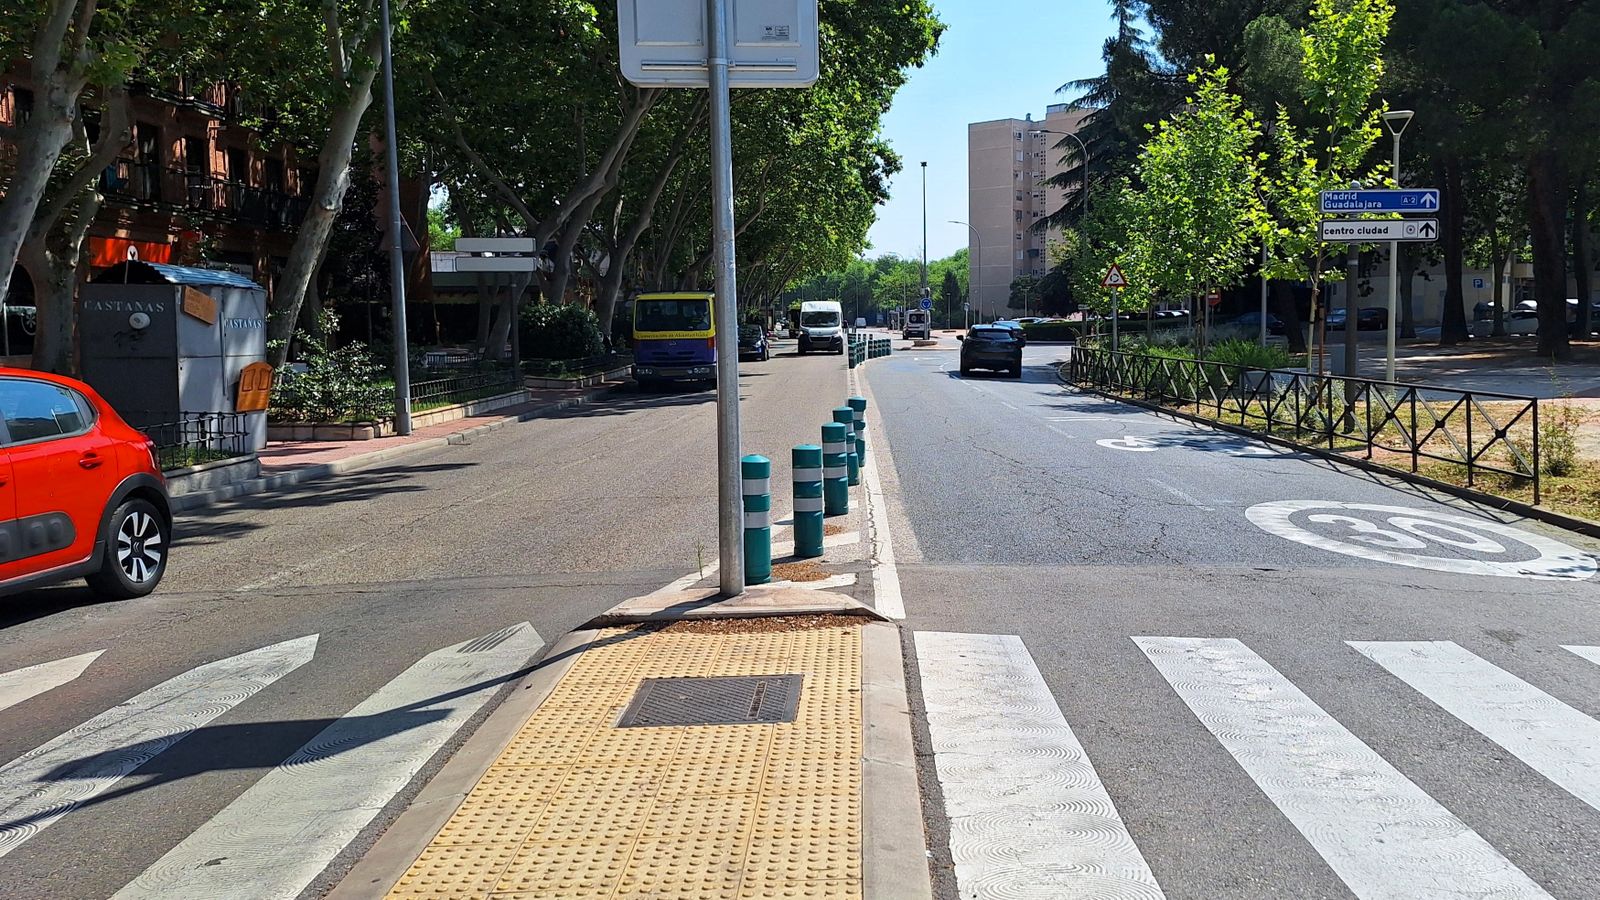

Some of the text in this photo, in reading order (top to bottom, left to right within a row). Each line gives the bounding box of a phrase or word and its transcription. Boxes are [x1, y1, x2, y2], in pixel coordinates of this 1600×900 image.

[1324, 192, 1357, 200] Madrid
[1324, 200, 1382, 209] Guadalajara
[1324, 226, 1389, 235] centro ciudad
[1307, 514, 1507, 553] 30
